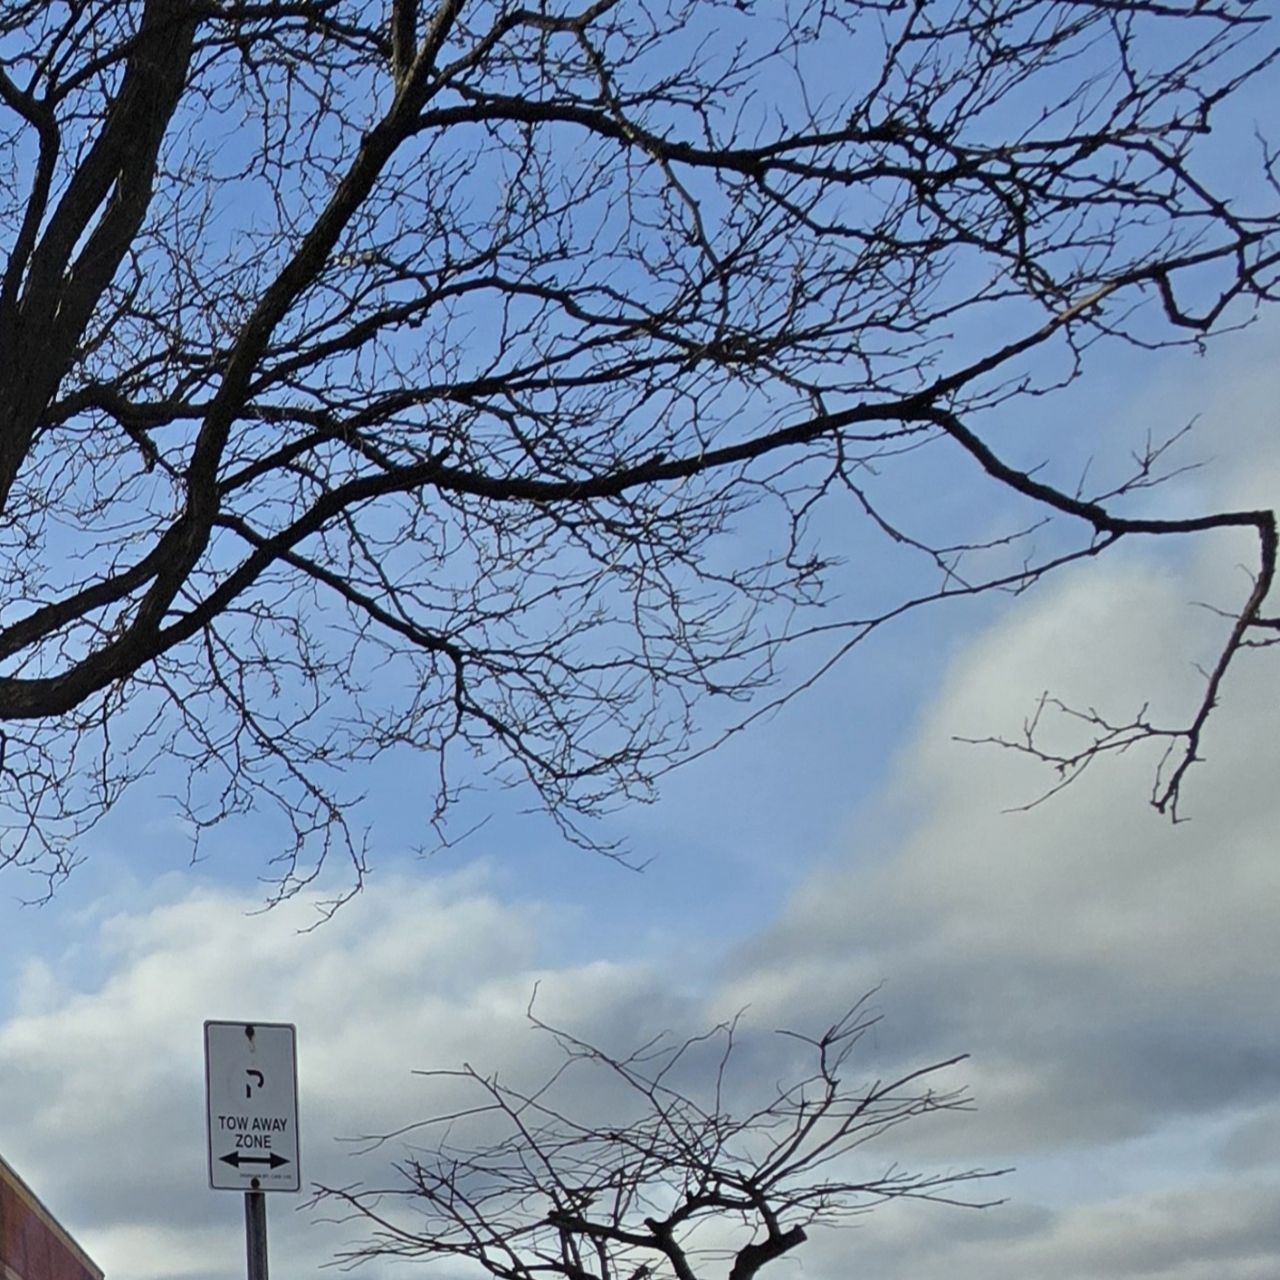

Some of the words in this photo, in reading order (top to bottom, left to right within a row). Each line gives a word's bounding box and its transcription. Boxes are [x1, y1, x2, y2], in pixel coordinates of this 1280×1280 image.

[218, 1116, 249, 1130] TOW
[252, 1117, 288, 1132] AWAY
[235, 1134, 272, 1148] ZONE
